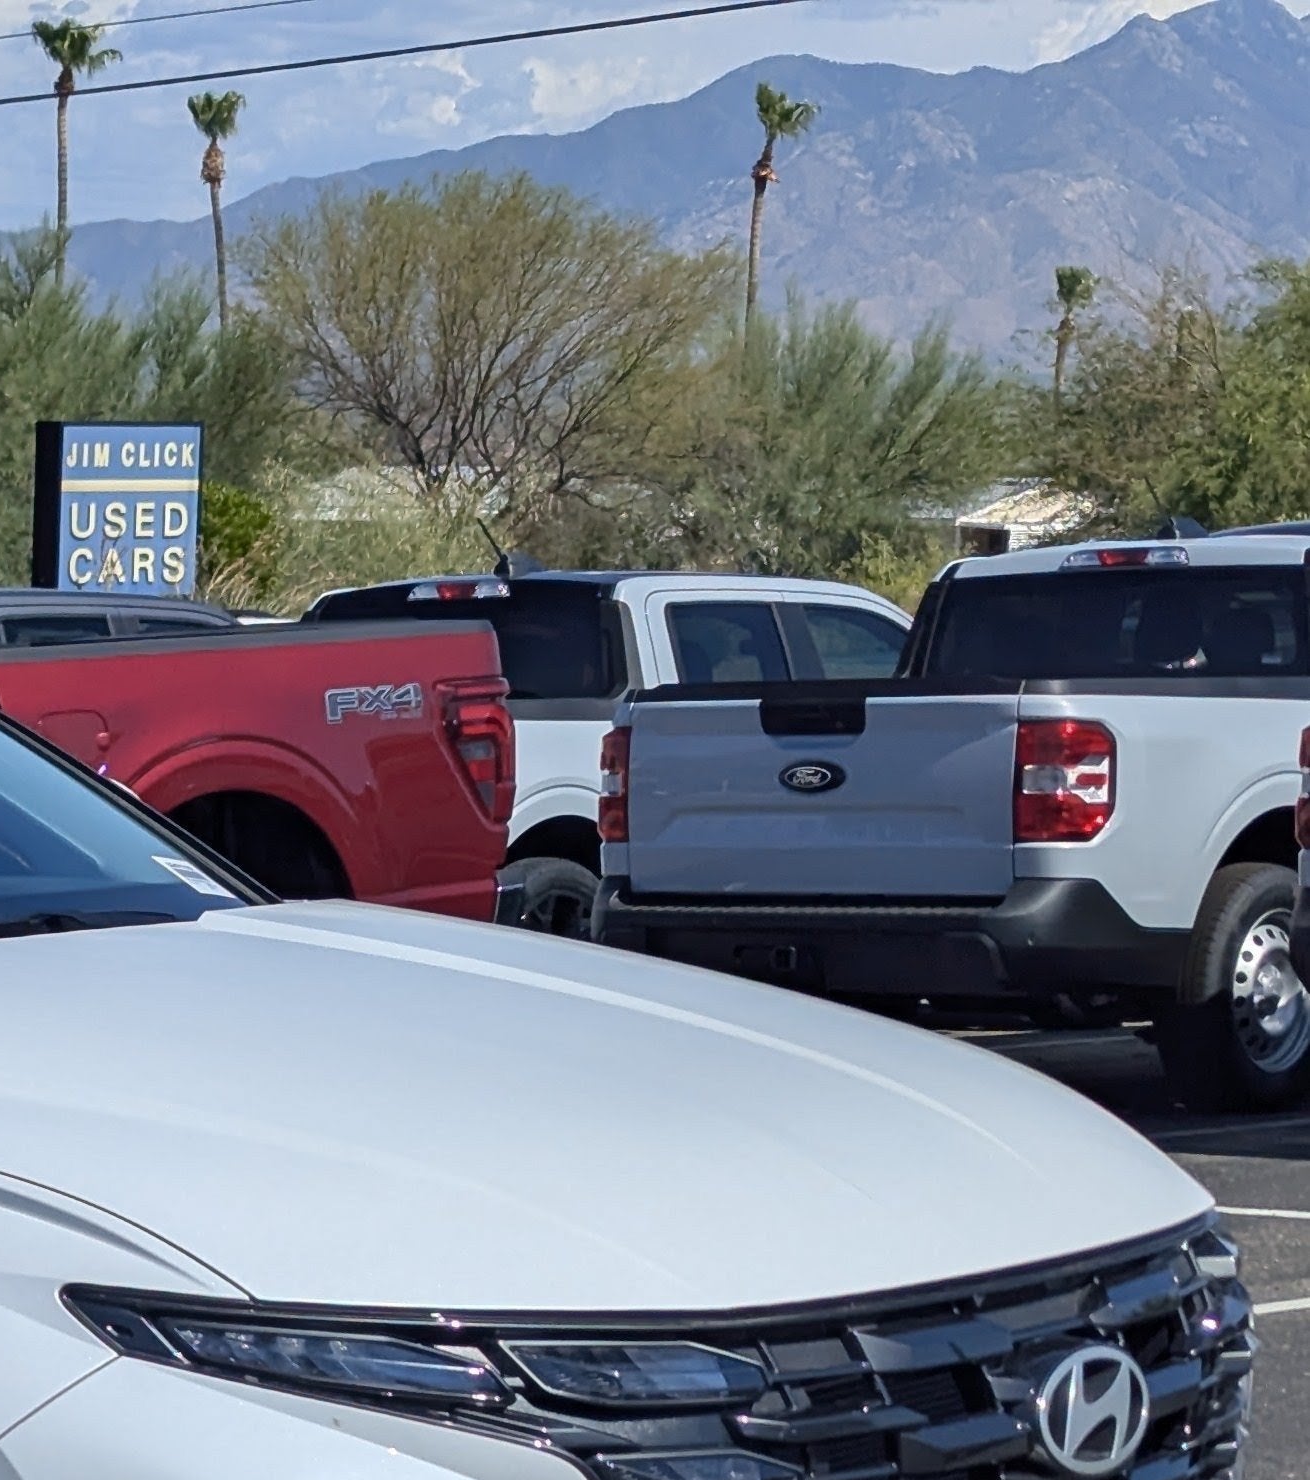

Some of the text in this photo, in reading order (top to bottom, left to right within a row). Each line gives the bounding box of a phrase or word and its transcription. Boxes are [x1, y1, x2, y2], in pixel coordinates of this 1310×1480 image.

[66, 441, 195, 468] JIM CLICK
[70, 502, 188, 538] USED
[69, 547, 185, 584] CARS
[324, 683, 423, 724] FX4
